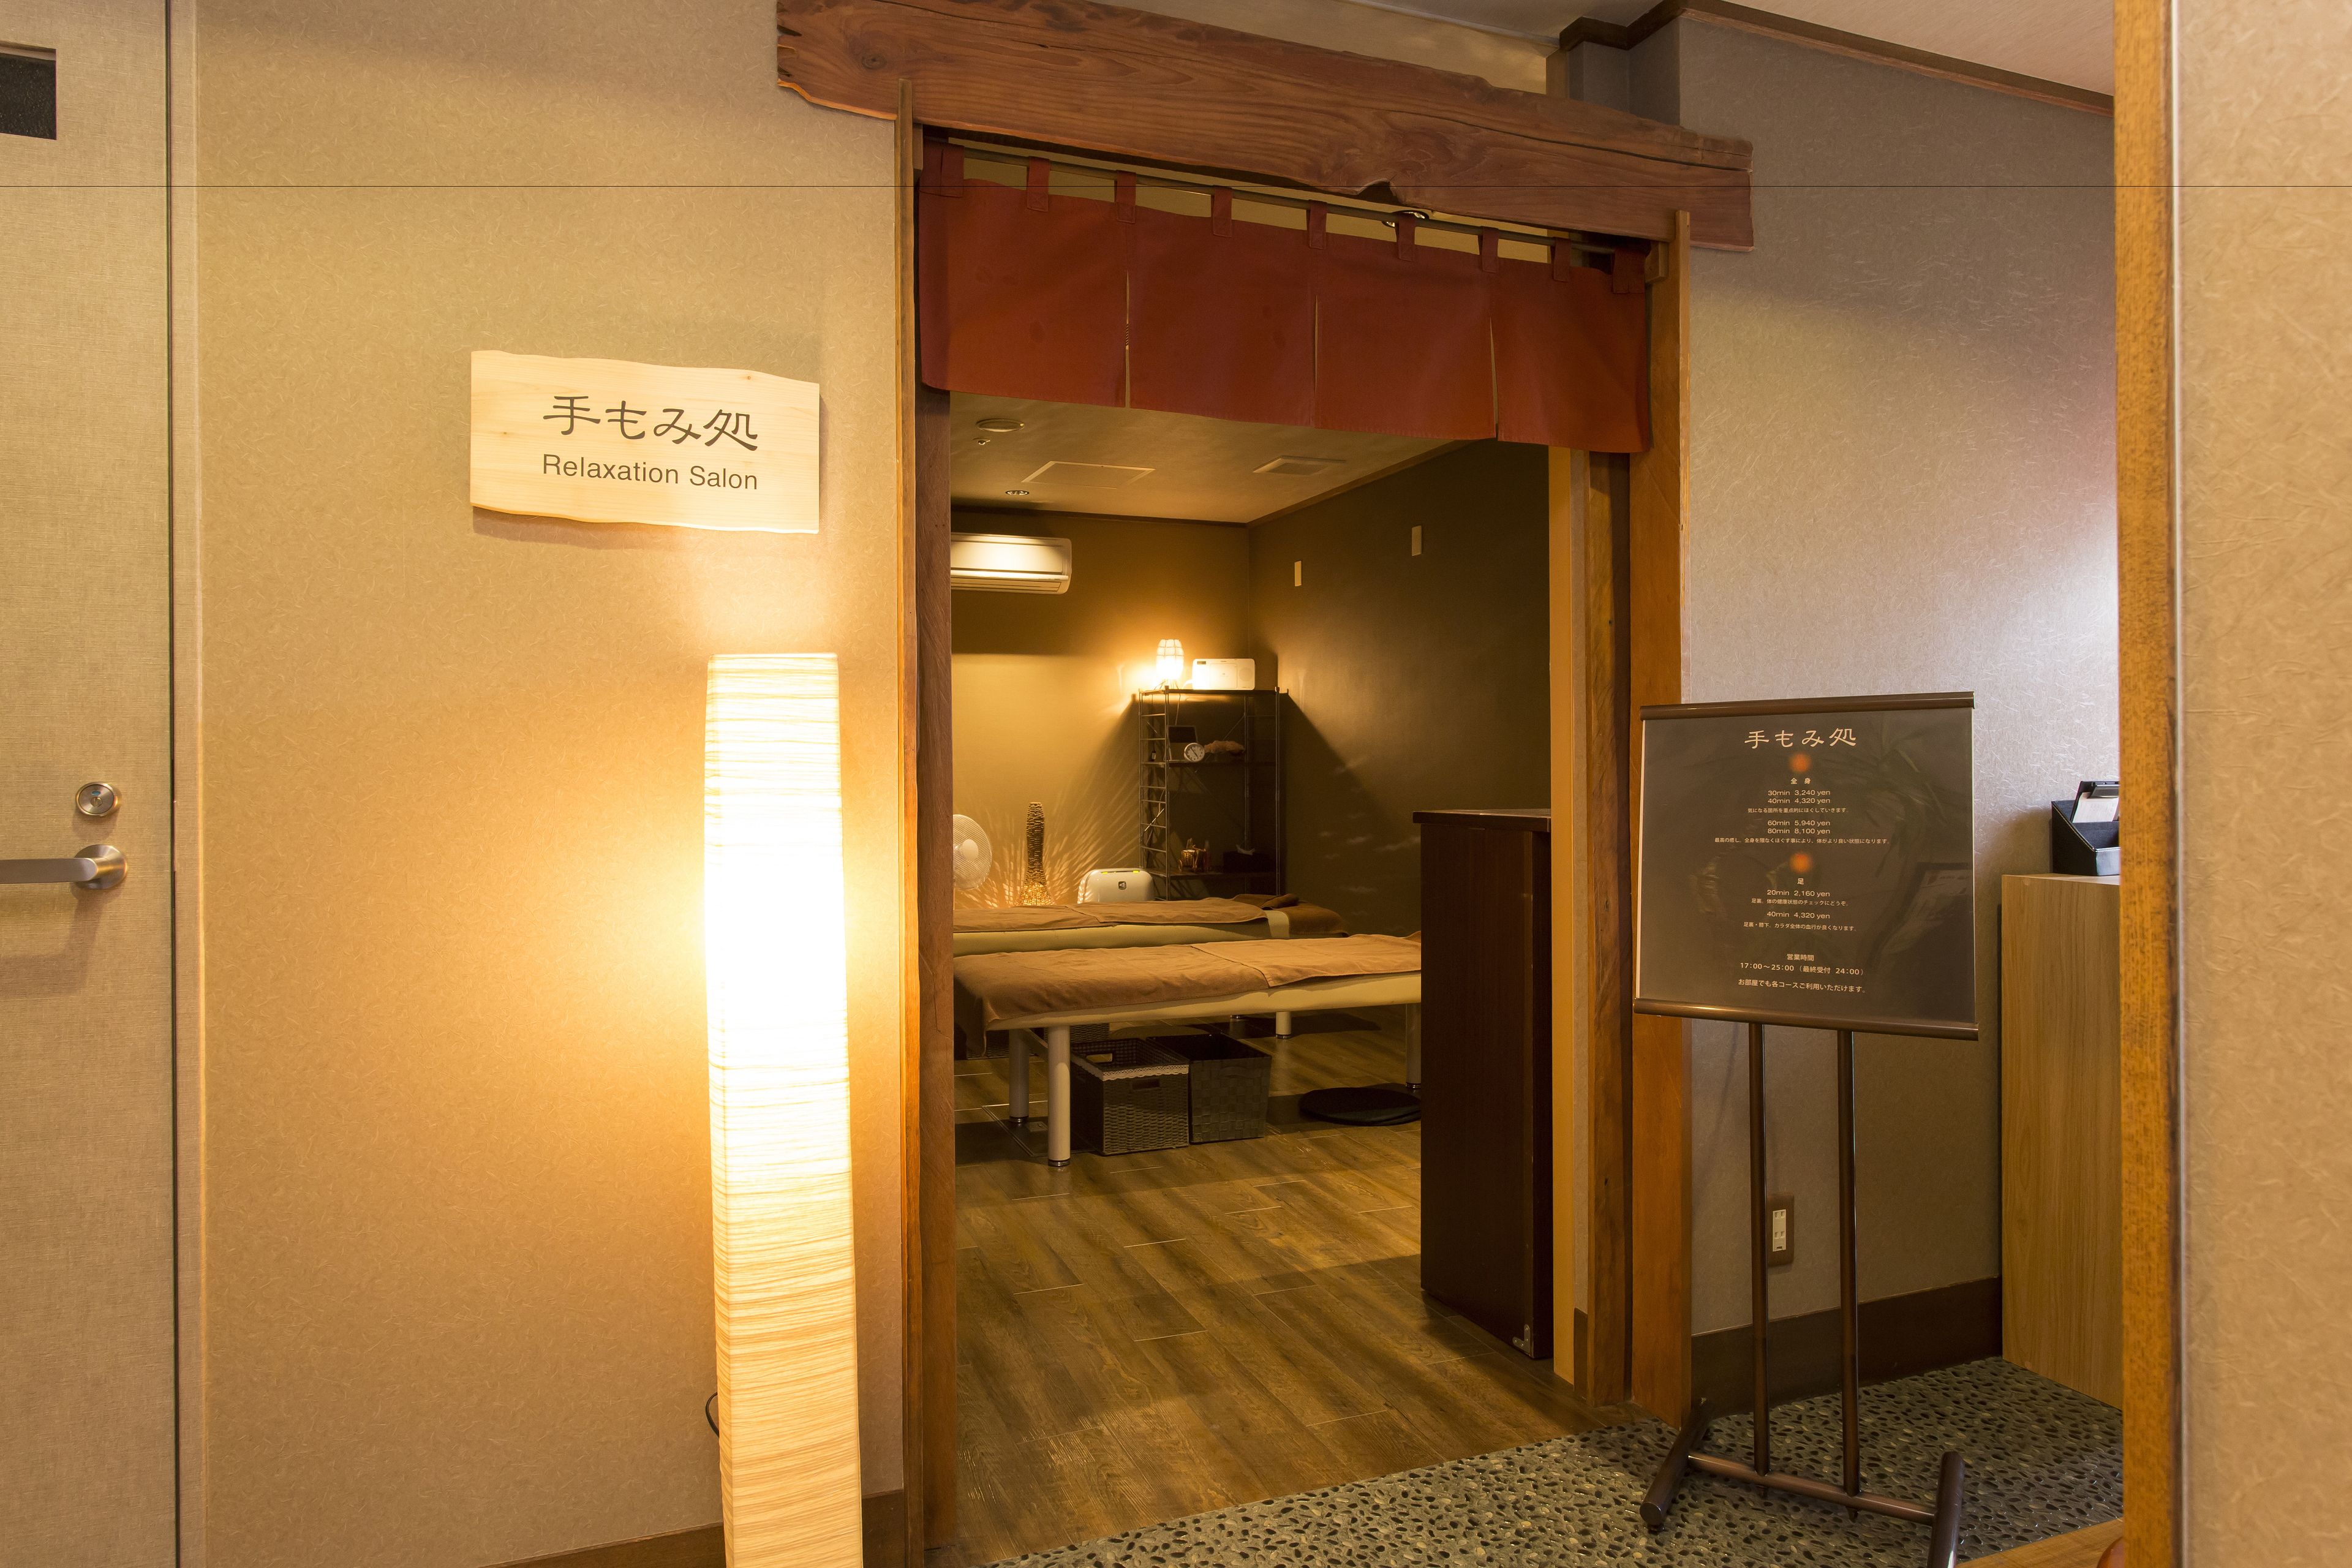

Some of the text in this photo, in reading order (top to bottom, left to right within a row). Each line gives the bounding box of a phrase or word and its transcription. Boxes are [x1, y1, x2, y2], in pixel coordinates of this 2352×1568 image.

[543, 396, 758, 451] 手もみ処
[543, 454, 758, 489] Relaxation Salon
[1744, 728, 1856, 748] 手もみ処
[1738, 979, 1866, 993] お部屋でも各コースご利用いただけます。
